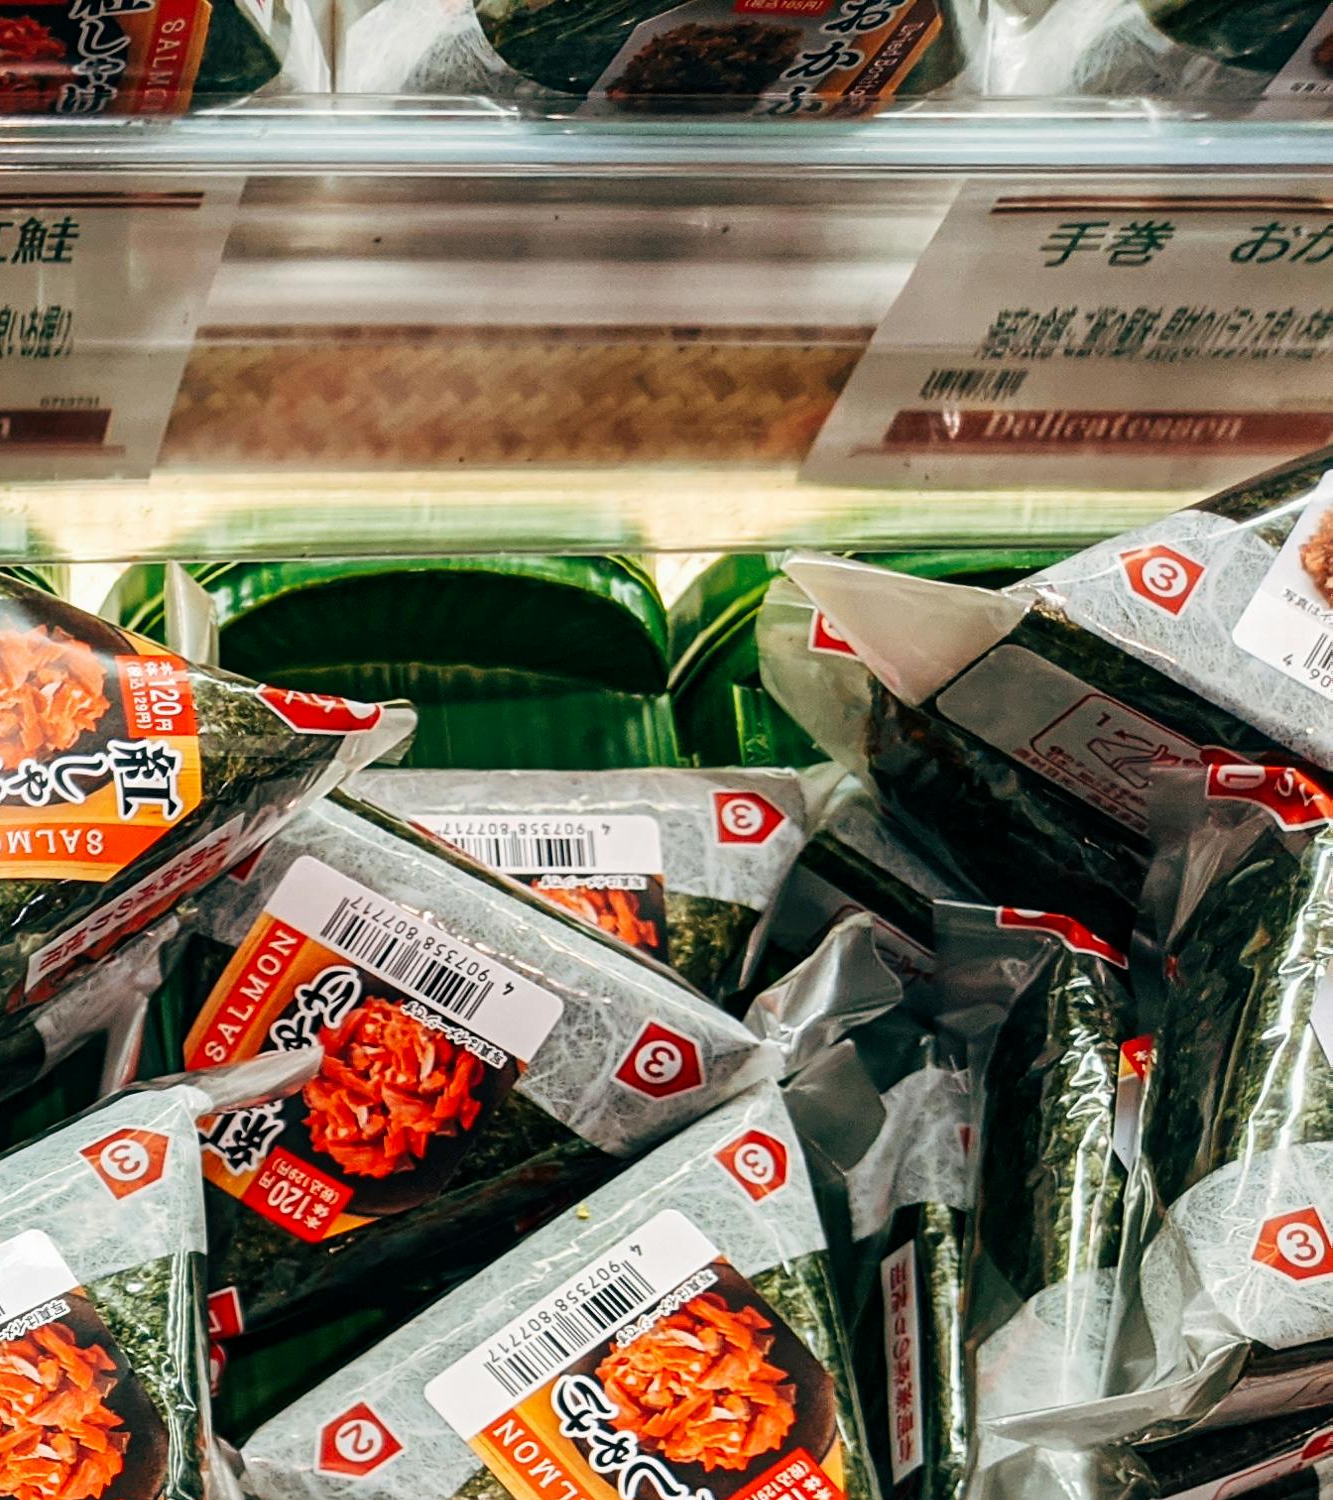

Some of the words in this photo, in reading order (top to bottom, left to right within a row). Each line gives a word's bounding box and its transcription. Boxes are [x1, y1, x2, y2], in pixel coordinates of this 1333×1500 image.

[1039, 220, 1176, 268] 手巻
[124, 659, 152, 730] (税込129円)
[442, 821, 510, 834] 807717
[518, 822, 585, 836] 907358
[601, 823, 612, 837] 4
[202, 929, 299, 1065] SALMON
[196, 966, 357, 1173] 紅ゃけ
[270, 1155, 343, 1207] (税込129円)
